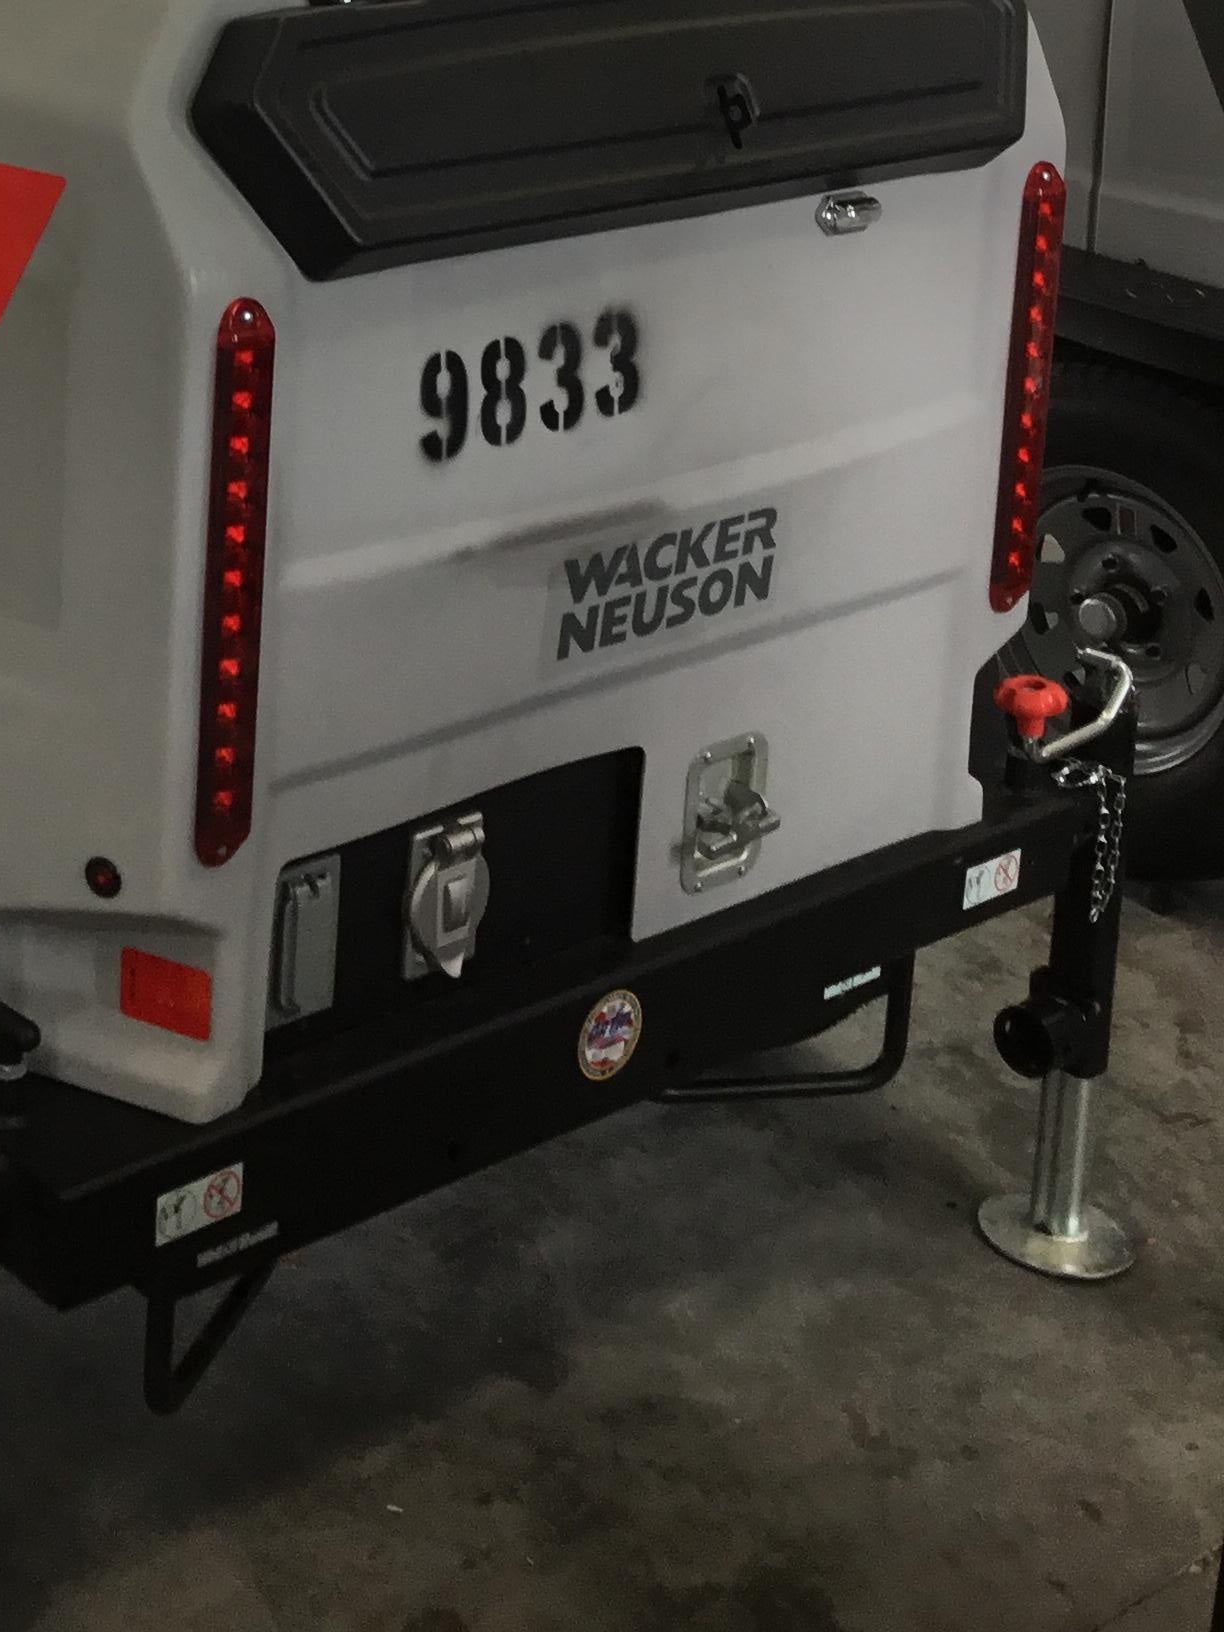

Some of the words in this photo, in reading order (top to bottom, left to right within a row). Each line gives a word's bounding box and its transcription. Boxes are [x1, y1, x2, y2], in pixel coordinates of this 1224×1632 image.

[419, 306, 642, 463] 9833
[556, 554, 776, 661] NEUSON
[563, 506, 778, 605] WACKER
